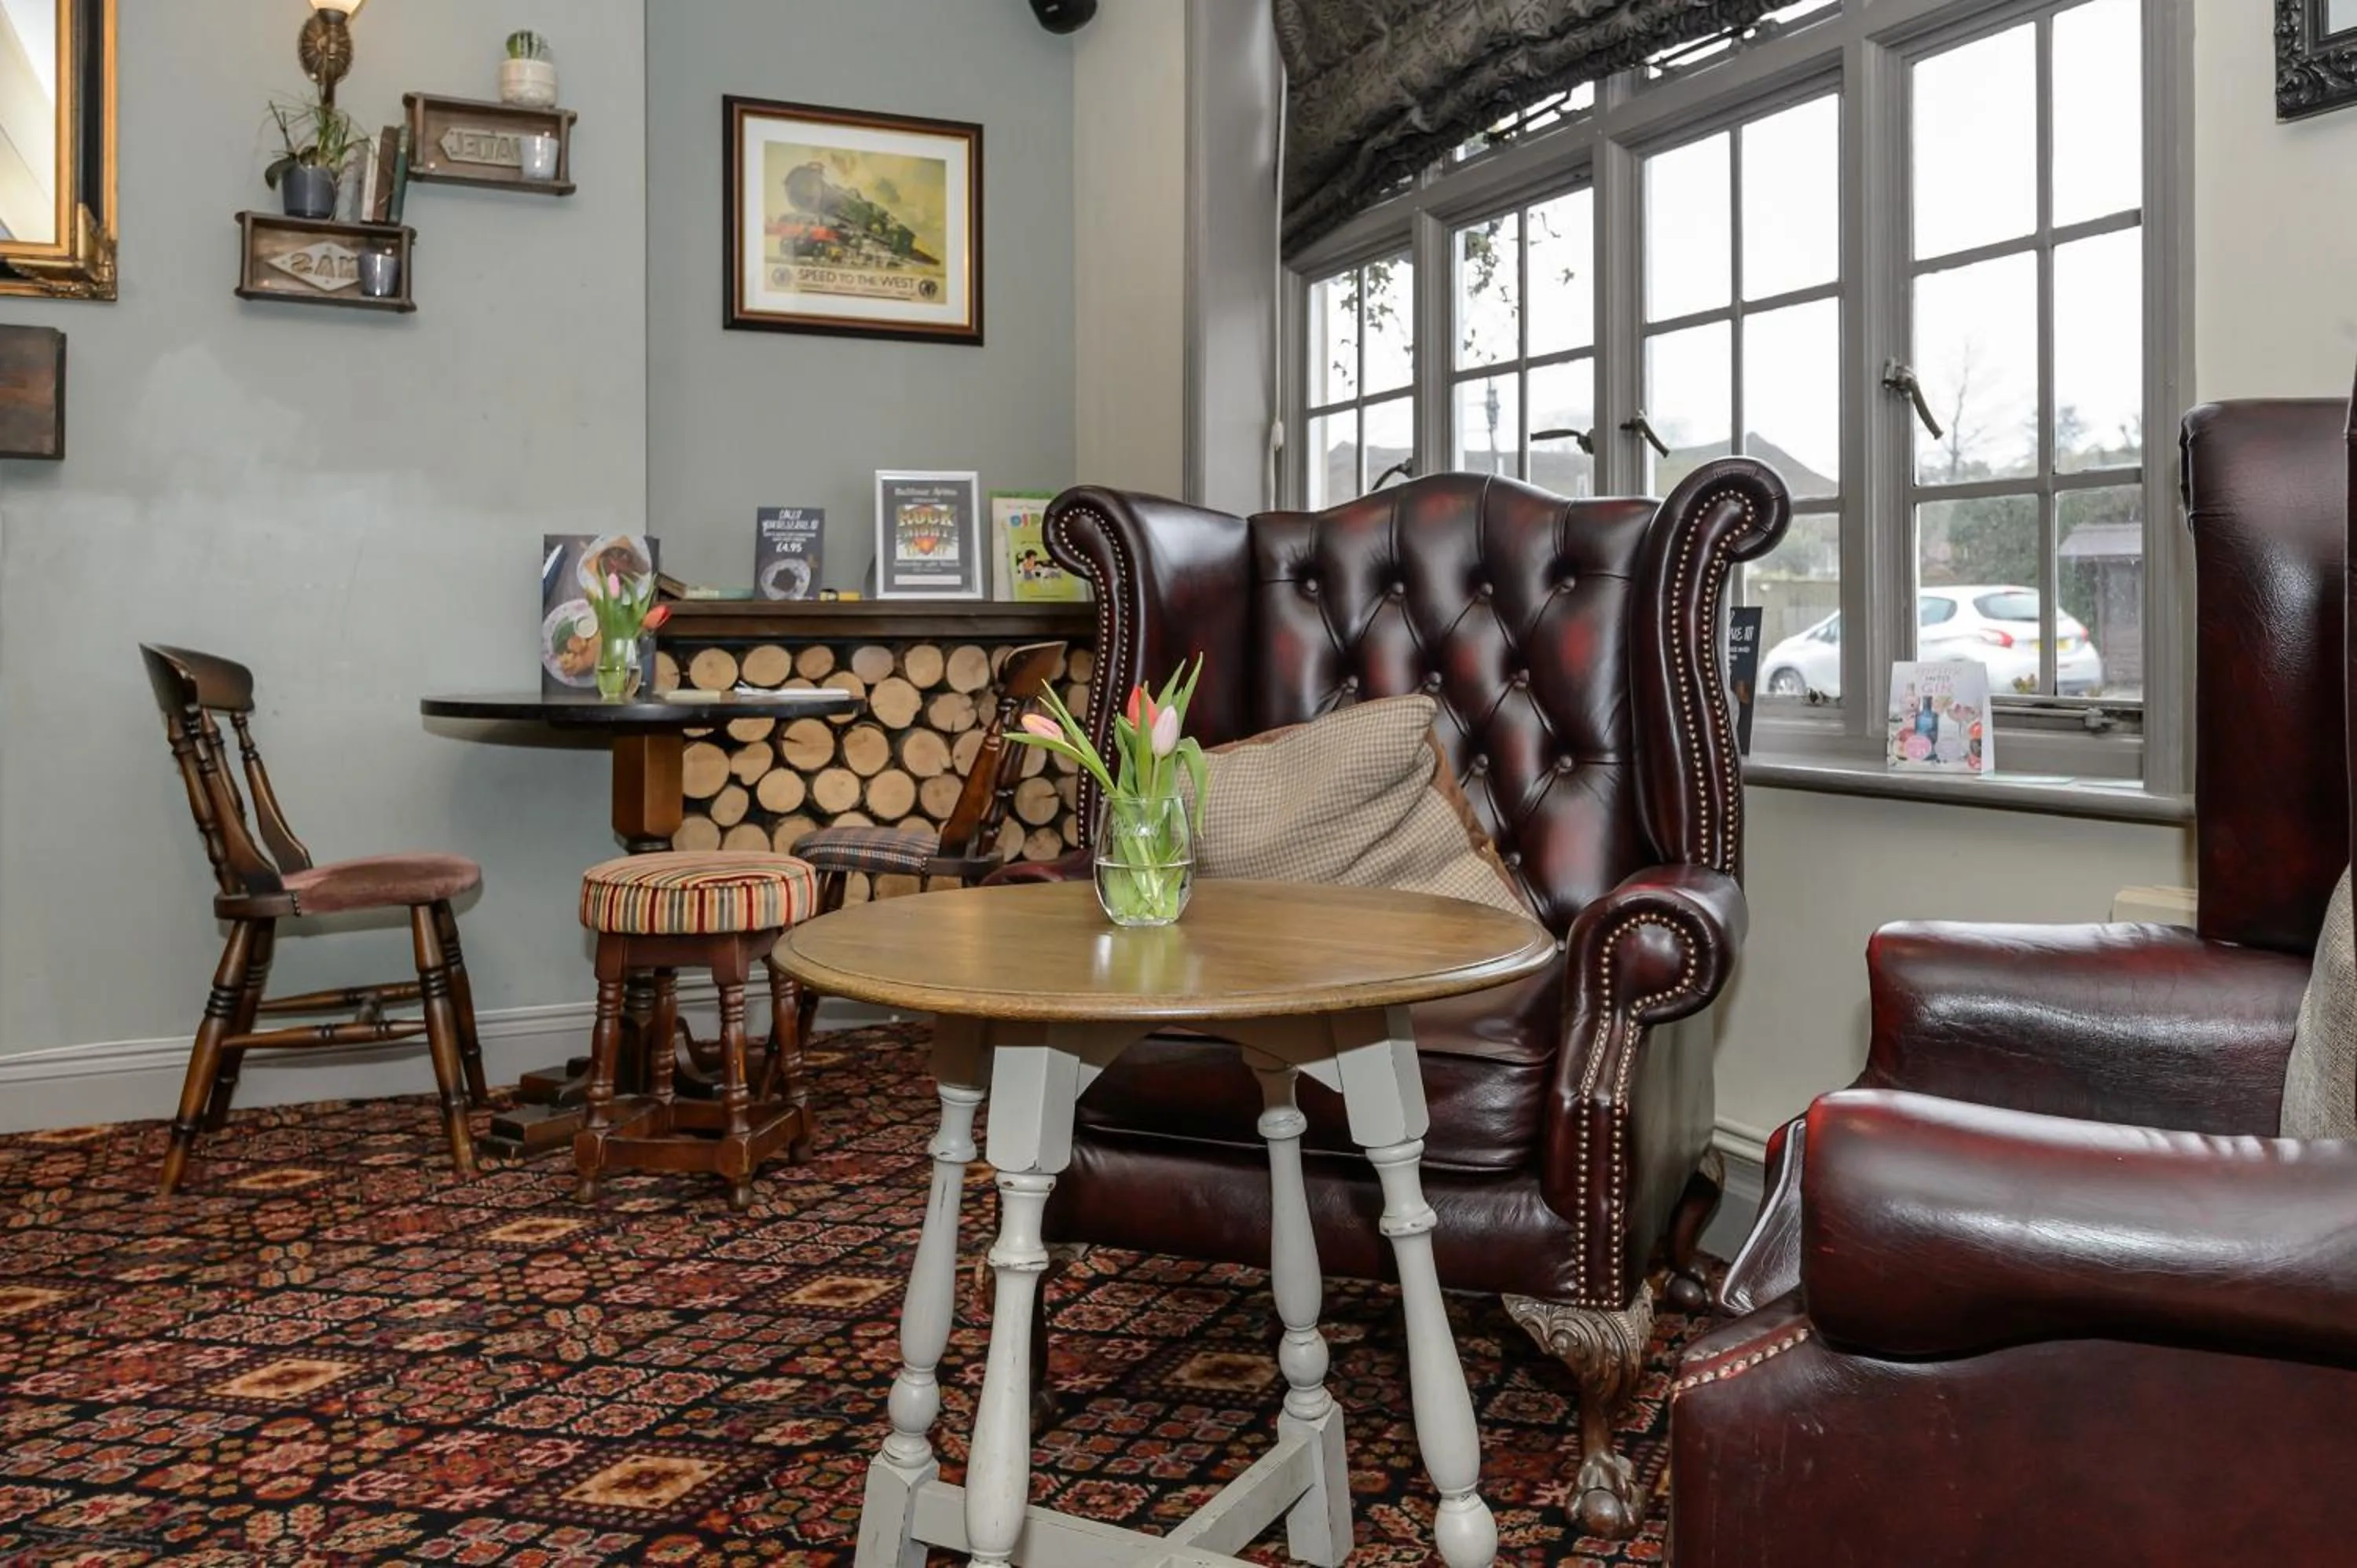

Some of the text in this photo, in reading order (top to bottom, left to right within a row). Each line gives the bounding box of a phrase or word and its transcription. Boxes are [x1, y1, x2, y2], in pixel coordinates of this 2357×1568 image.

[797, 268, 837, 284] SPEED
[839, 273, 855, 284] TO
[857, 274, 877, 286] THE
[880, 276, 915, 289] WEST
[897, 511, 955, 527] ROCK
[775, 542, 802, 553] £4.95
